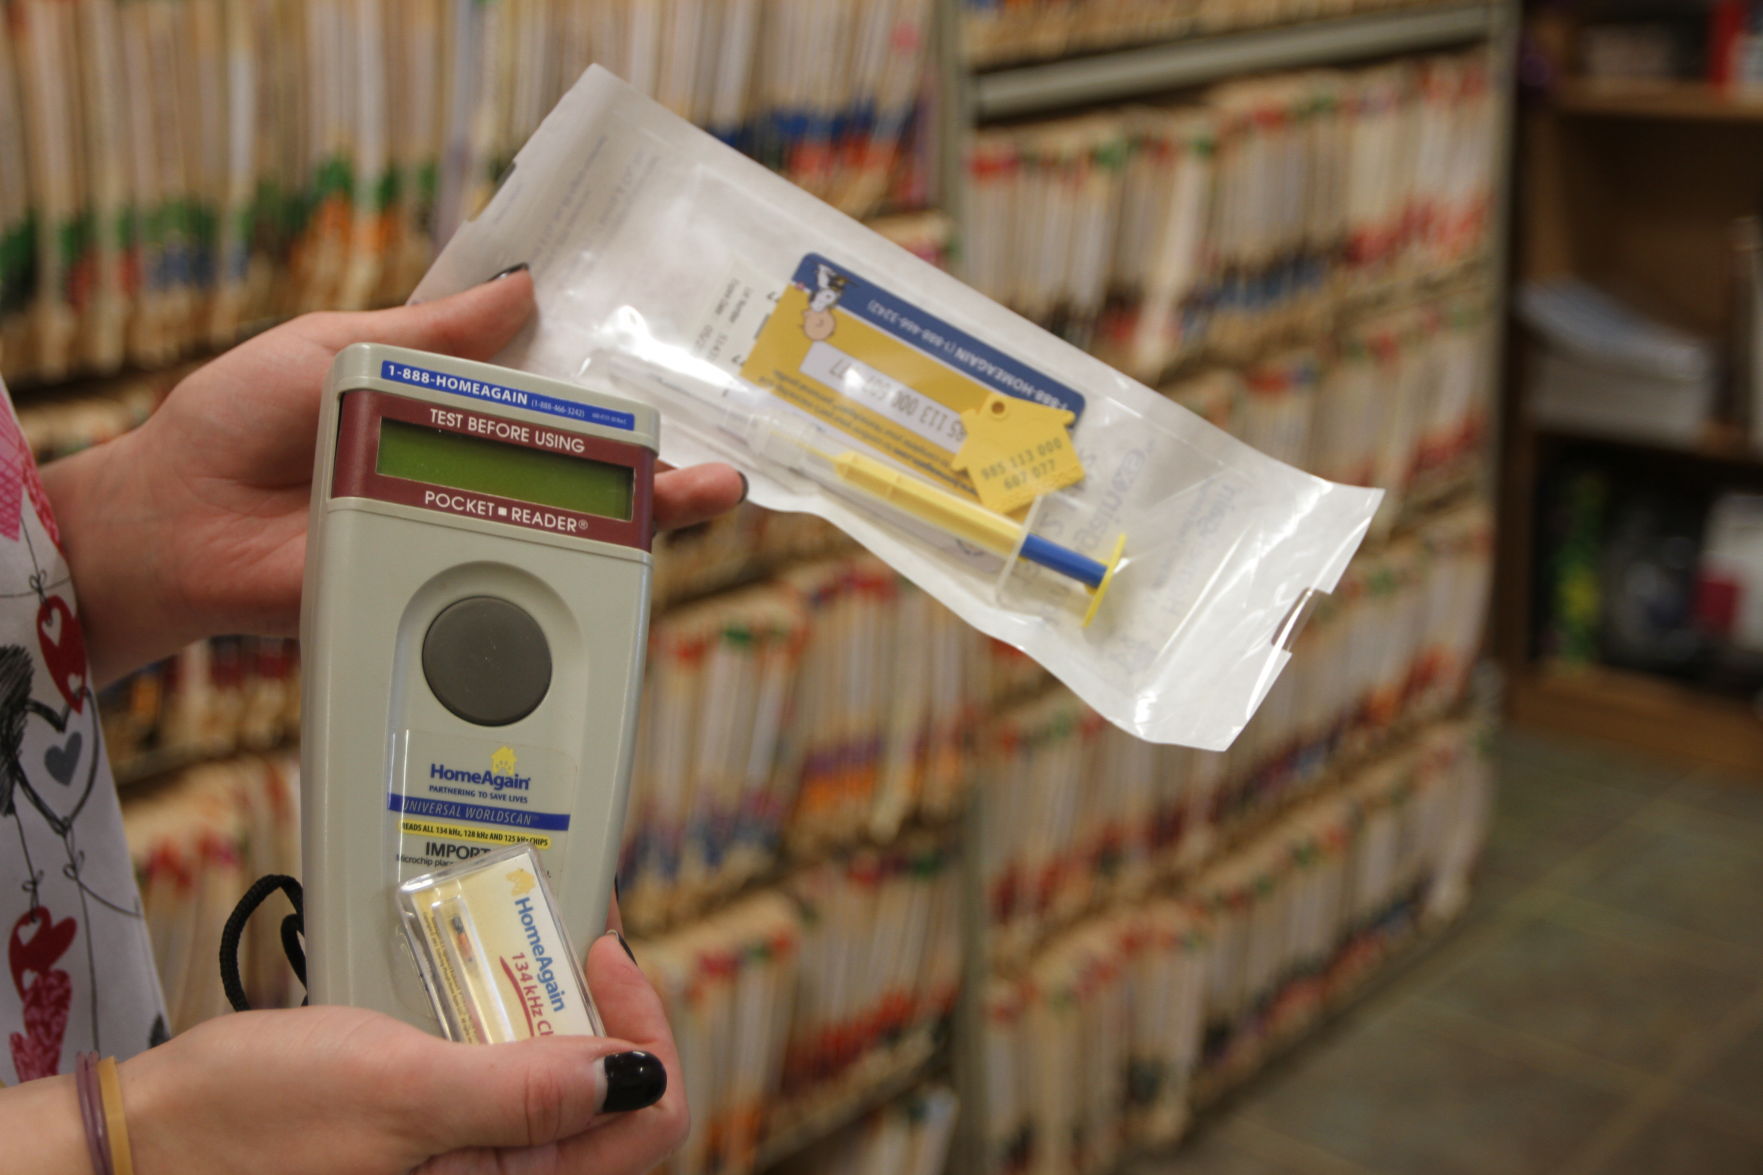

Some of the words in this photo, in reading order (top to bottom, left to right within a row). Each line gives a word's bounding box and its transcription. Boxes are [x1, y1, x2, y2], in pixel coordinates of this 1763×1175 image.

[387, 365, 528, 406] 1-888-HOMEAGAIN
[430, 408, 464, 428] TEST
[468, 415, 530, 443] BEFORE
[535, 431, 586, 453] USING
[424, 490, 495, 517] POCKET
[403, 800, 461, 817] UNIVERSAL
[429, 785, 476, 798] PARTNERING
[478, 790, 488, 799] TO
[490, 792, 507, 802] SAVE
[508, 795, 529, 804] LIVES
[422, 824, 434, 833] ALL
[436, 826, 448, 835] 134
[464, 829, 476, 838] 128
[476, 830, 489, 840] kHz
[489, 832, 503, 841] AND
[504, 834, 516, 843] 125
[514, 897, 566, 1012] HomeAgain
[512, 952, 534, 983] 134
[523, 984, 545, 1018] kHz
